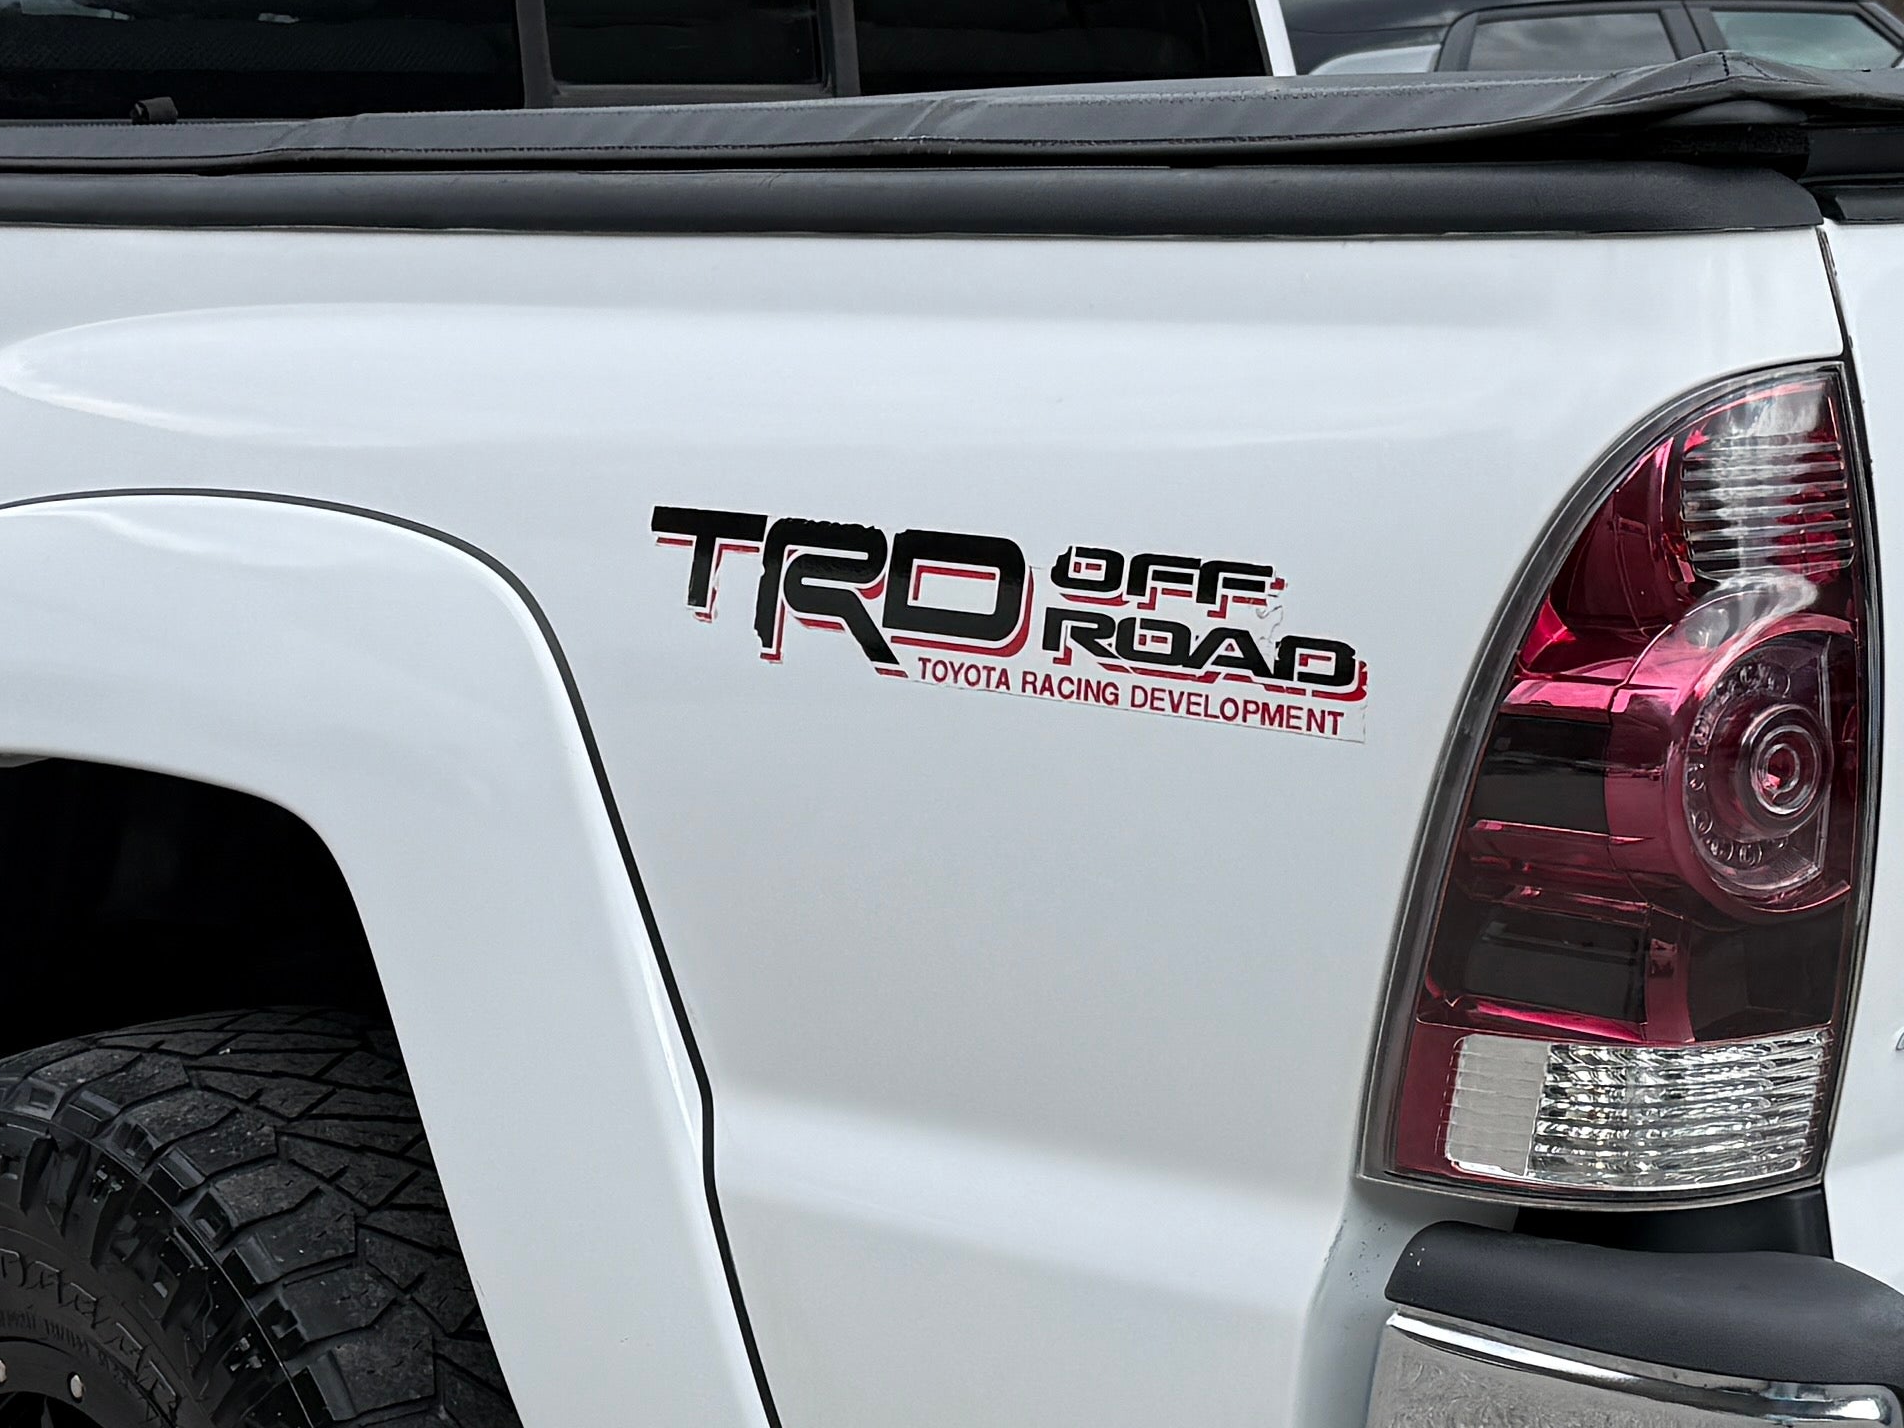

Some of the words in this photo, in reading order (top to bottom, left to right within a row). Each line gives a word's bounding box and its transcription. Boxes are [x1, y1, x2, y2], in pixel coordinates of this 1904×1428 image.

[650, 505, 1035, 679] TRD
[1050, 543, 1287, 619] OFF
[916, 655, 1013, 692] TOYOTA
[1020, 671, 1121, 707] RACING
[1129, 684, 1346, 737] DEVELOPMENT
[1041, 605, 1368, 702] ROAD
